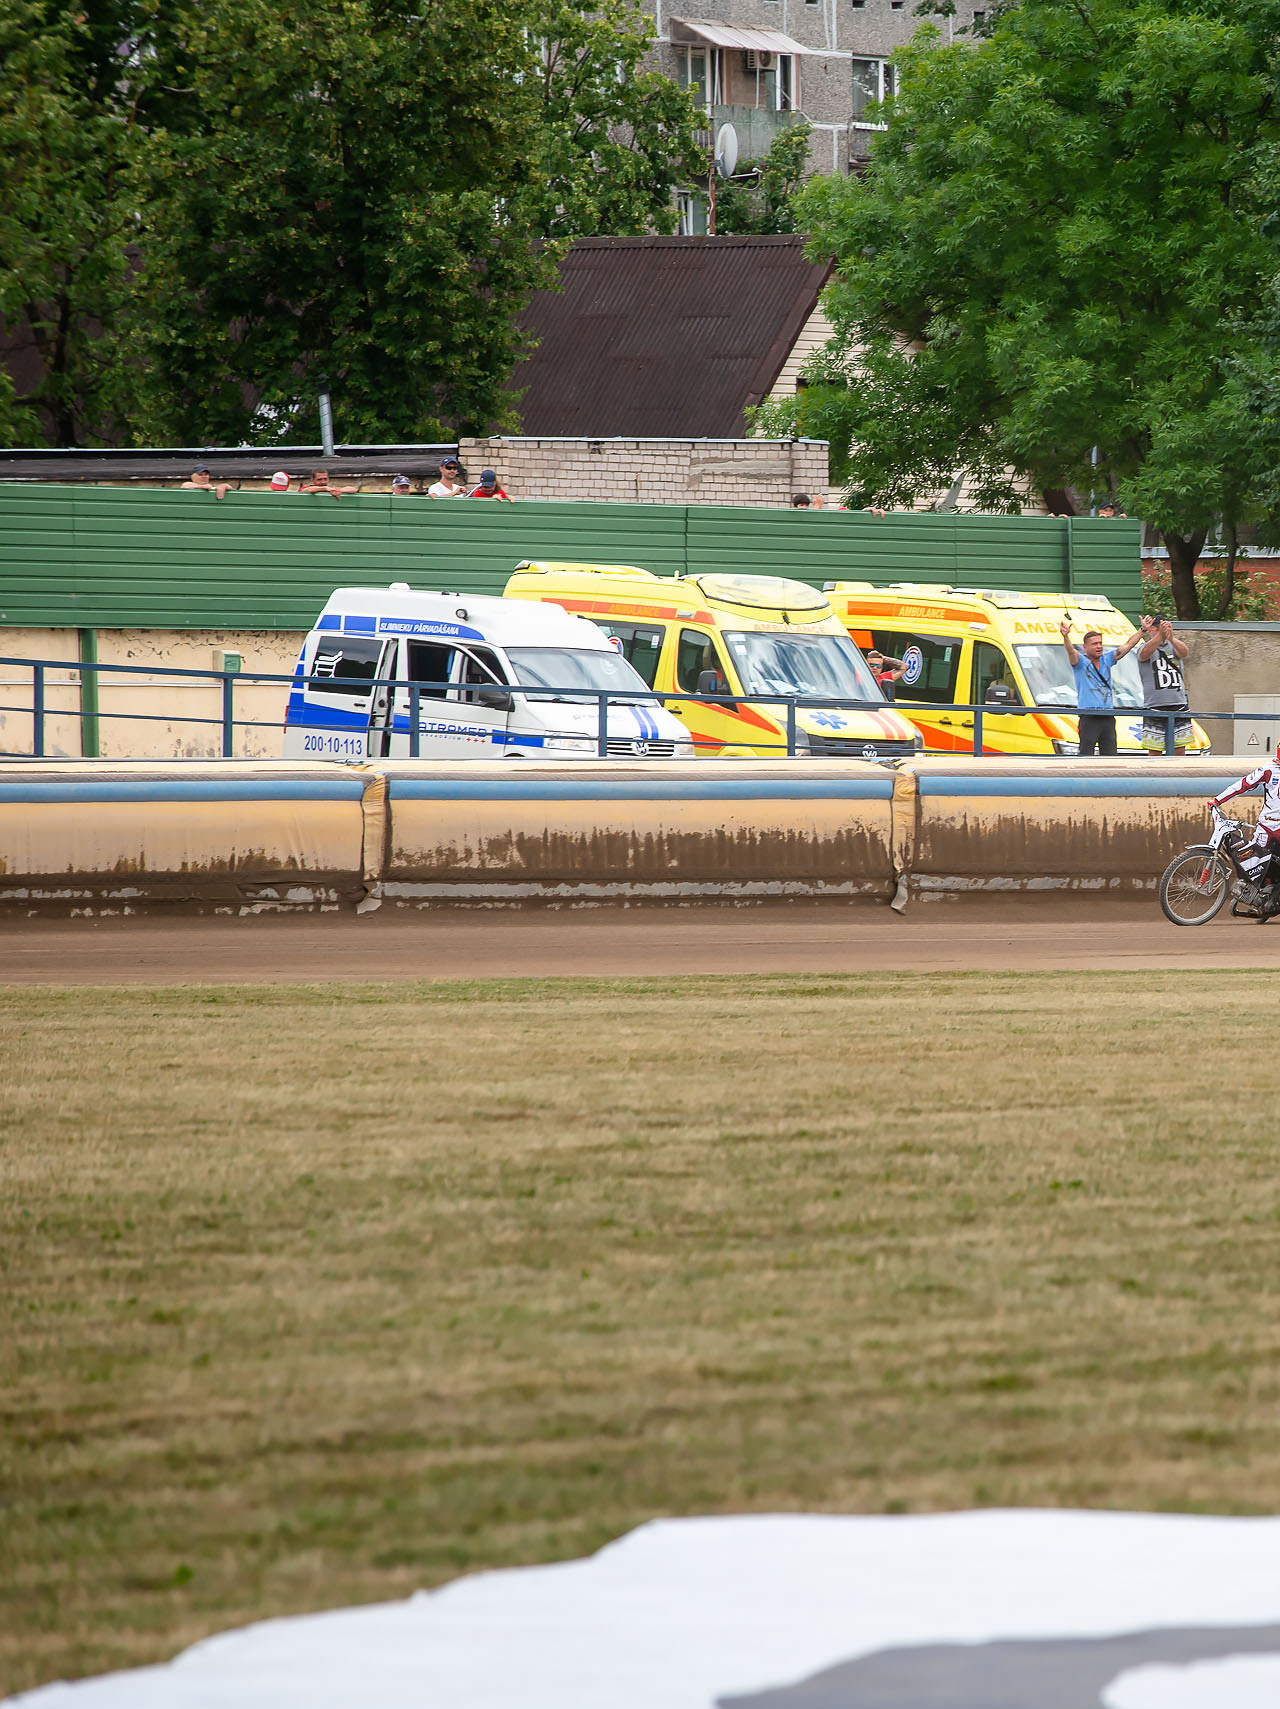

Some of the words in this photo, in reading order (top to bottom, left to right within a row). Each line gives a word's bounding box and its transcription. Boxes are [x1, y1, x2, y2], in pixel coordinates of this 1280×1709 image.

[607, 603, 661, 617] AMBULANCE
[898, 605, 946, 619] AMBULANCE
[753, 623, 826, 634] AMBULANCE
[1013, 621, 1132, 637] AMBLANCE
